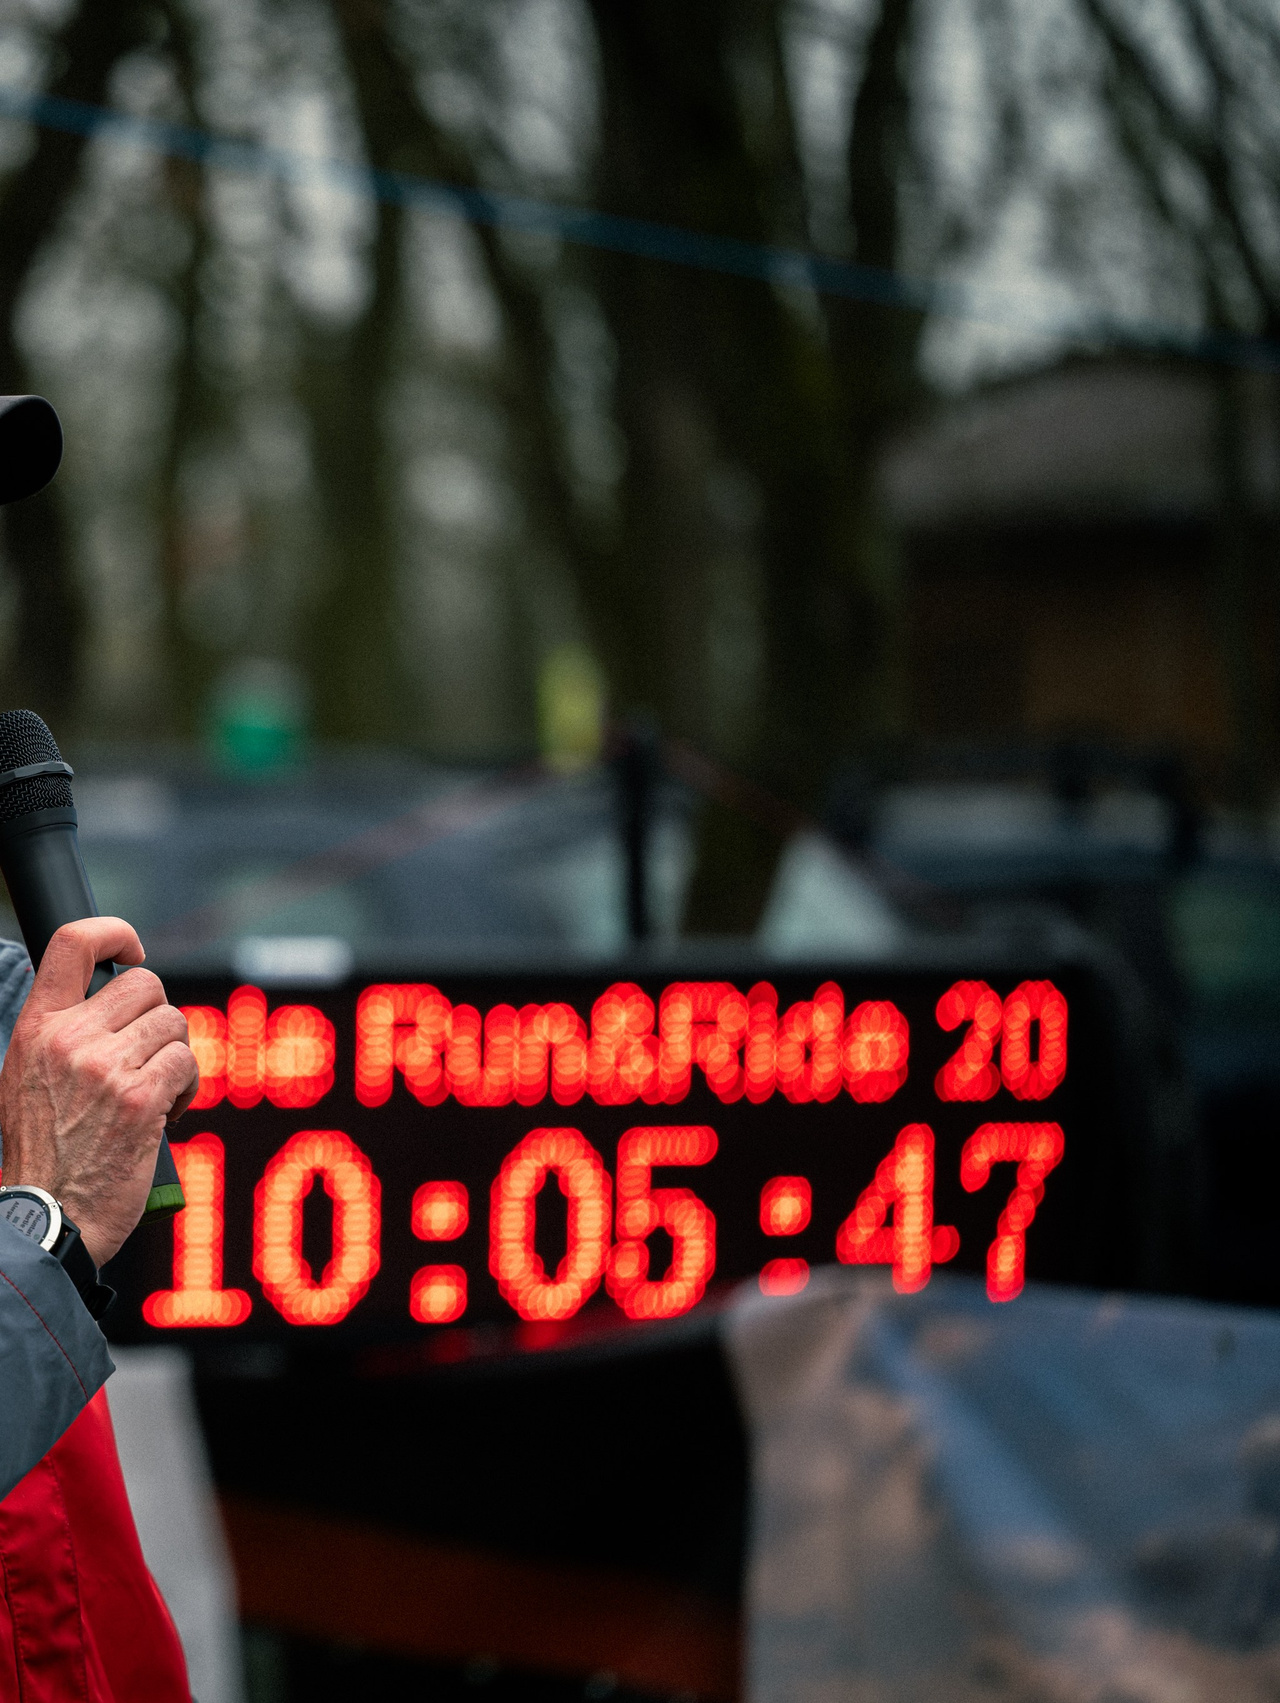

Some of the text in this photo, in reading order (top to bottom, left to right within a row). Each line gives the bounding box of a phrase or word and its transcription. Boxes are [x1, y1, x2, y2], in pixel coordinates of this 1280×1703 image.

[355, 981, 909, 1107] Run&Ride
[934, 980, 1068, 1102] 20
[142, 1123, 1064, 1328] 10:05:47
